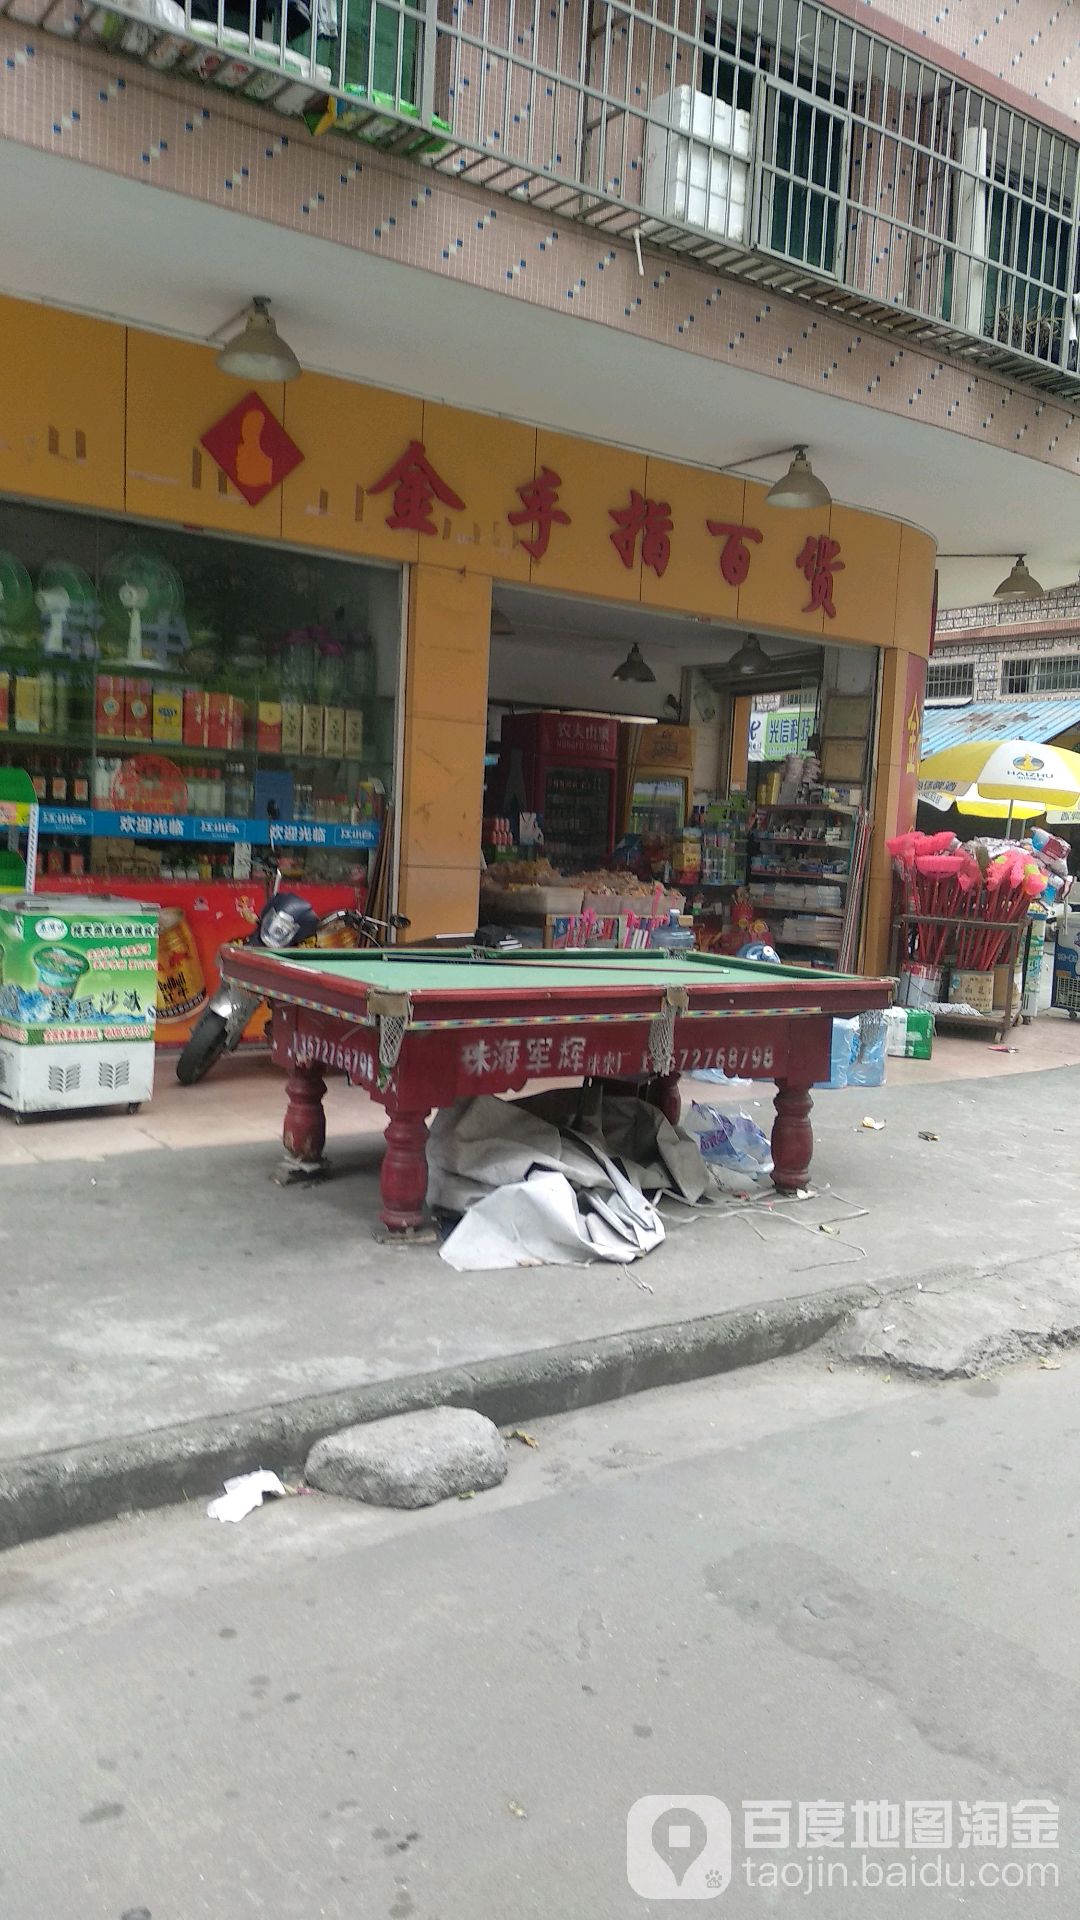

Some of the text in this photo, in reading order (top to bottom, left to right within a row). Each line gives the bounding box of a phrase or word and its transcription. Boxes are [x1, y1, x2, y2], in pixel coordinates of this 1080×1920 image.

[366, 439, 845, 618] 金手指百货
[769, 717, 816, 743] 光信科技
[1006, 770, 1055, 779] HAIZHU
[119, 815, 184, 836] 欢迎光临
[269, 824, 326, 843] 欢迎光临
[640, 1045, 774, 1072] 1672768798
